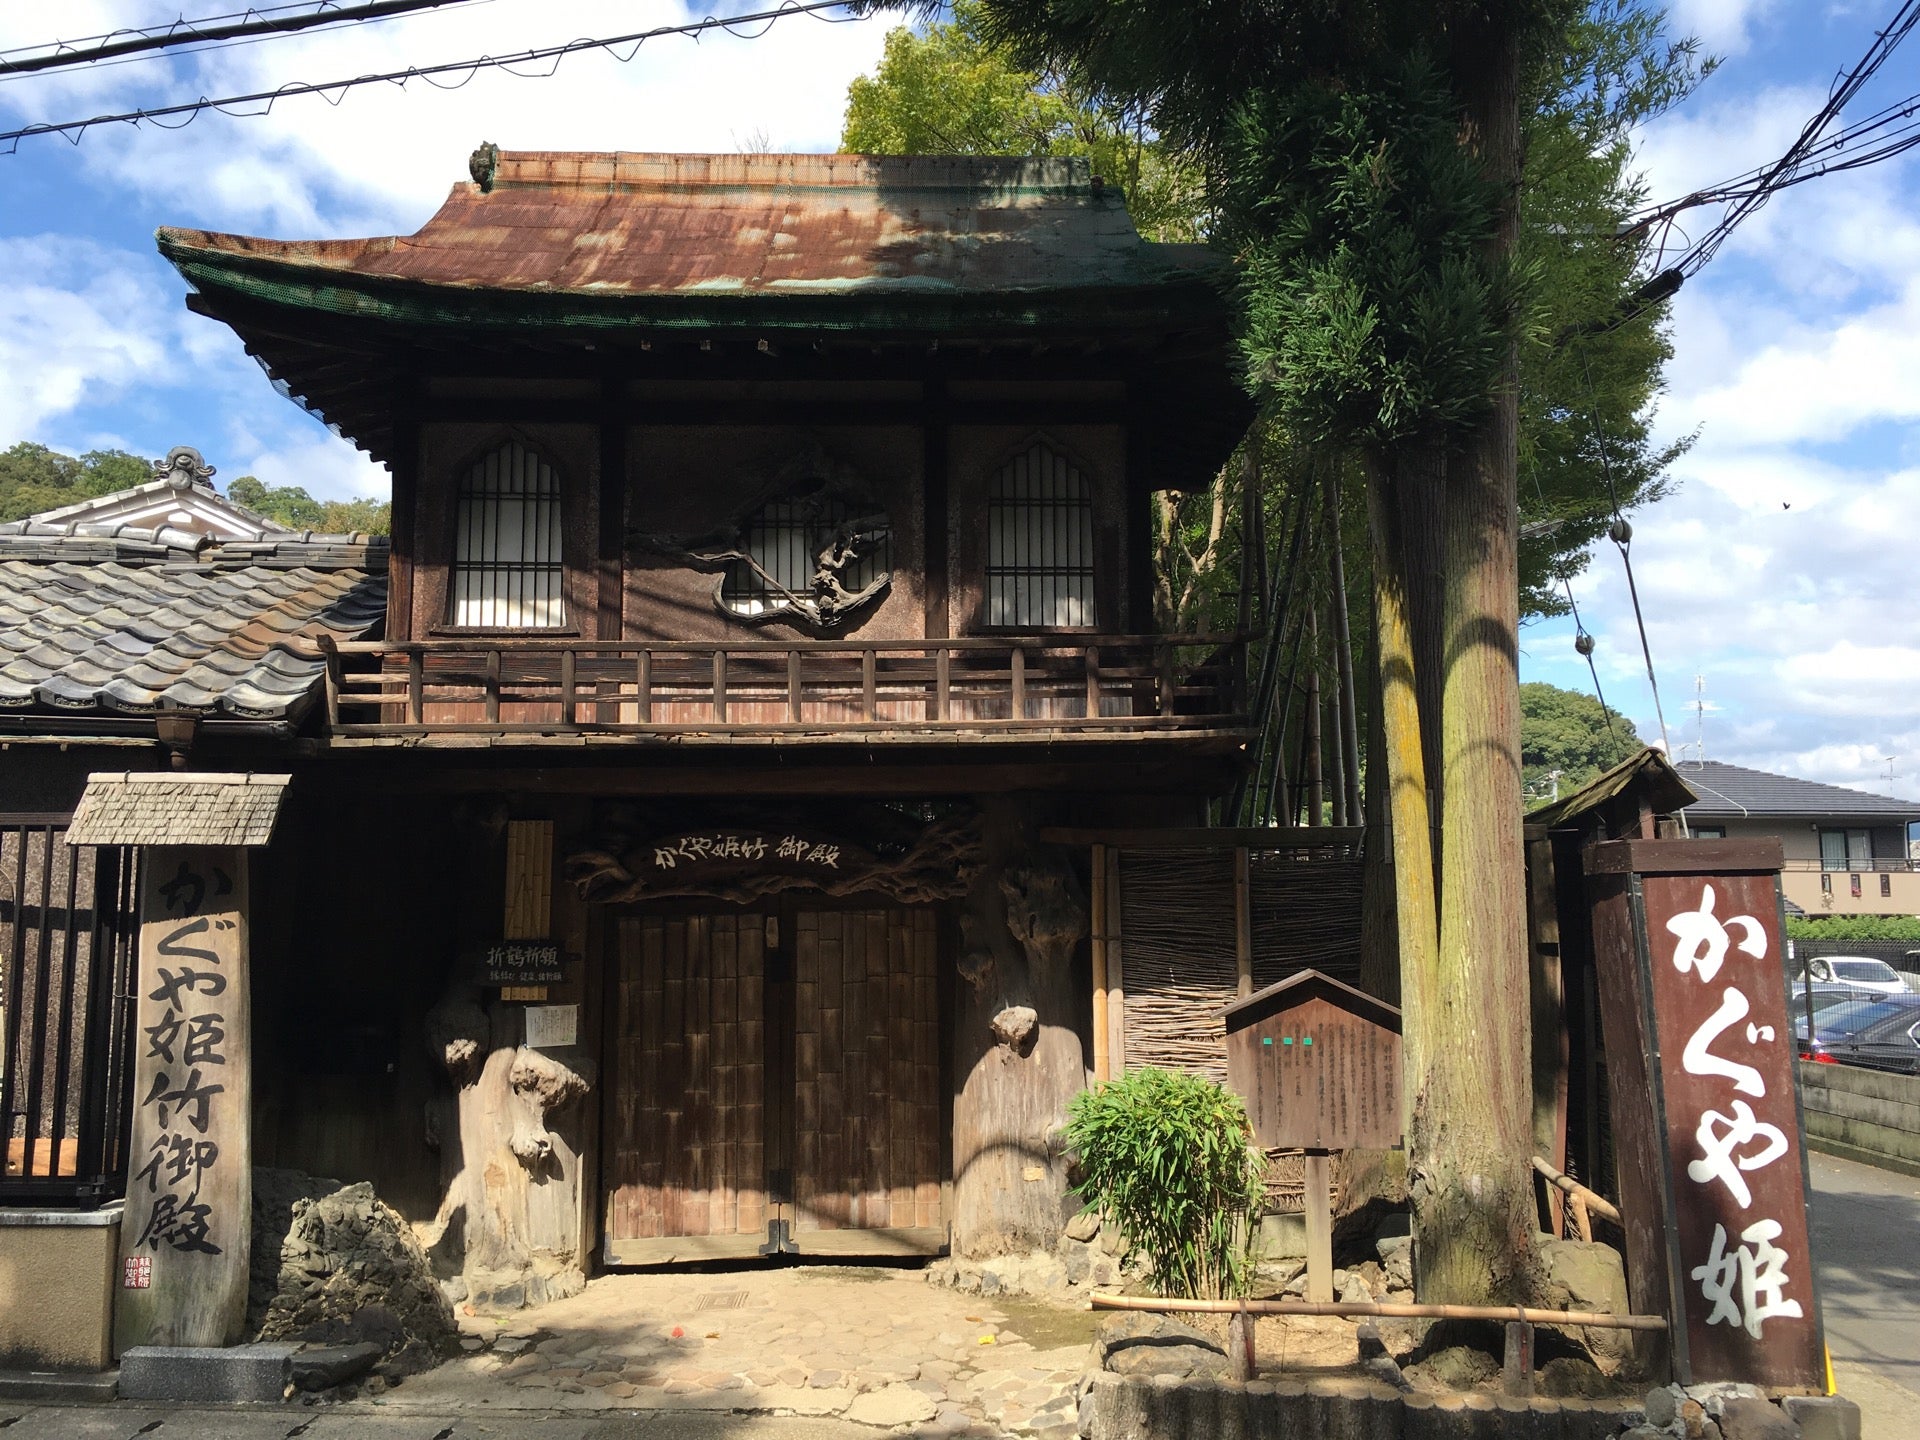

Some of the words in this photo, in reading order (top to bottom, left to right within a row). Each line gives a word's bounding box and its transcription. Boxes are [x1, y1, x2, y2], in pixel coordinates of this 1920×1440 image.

[134, 862, 235, 1256] かぐや姫竹御殿
[486, 946, 558, 967] 折鶴祈願
[1666, 883, 1804, 1340] かぐや姫
